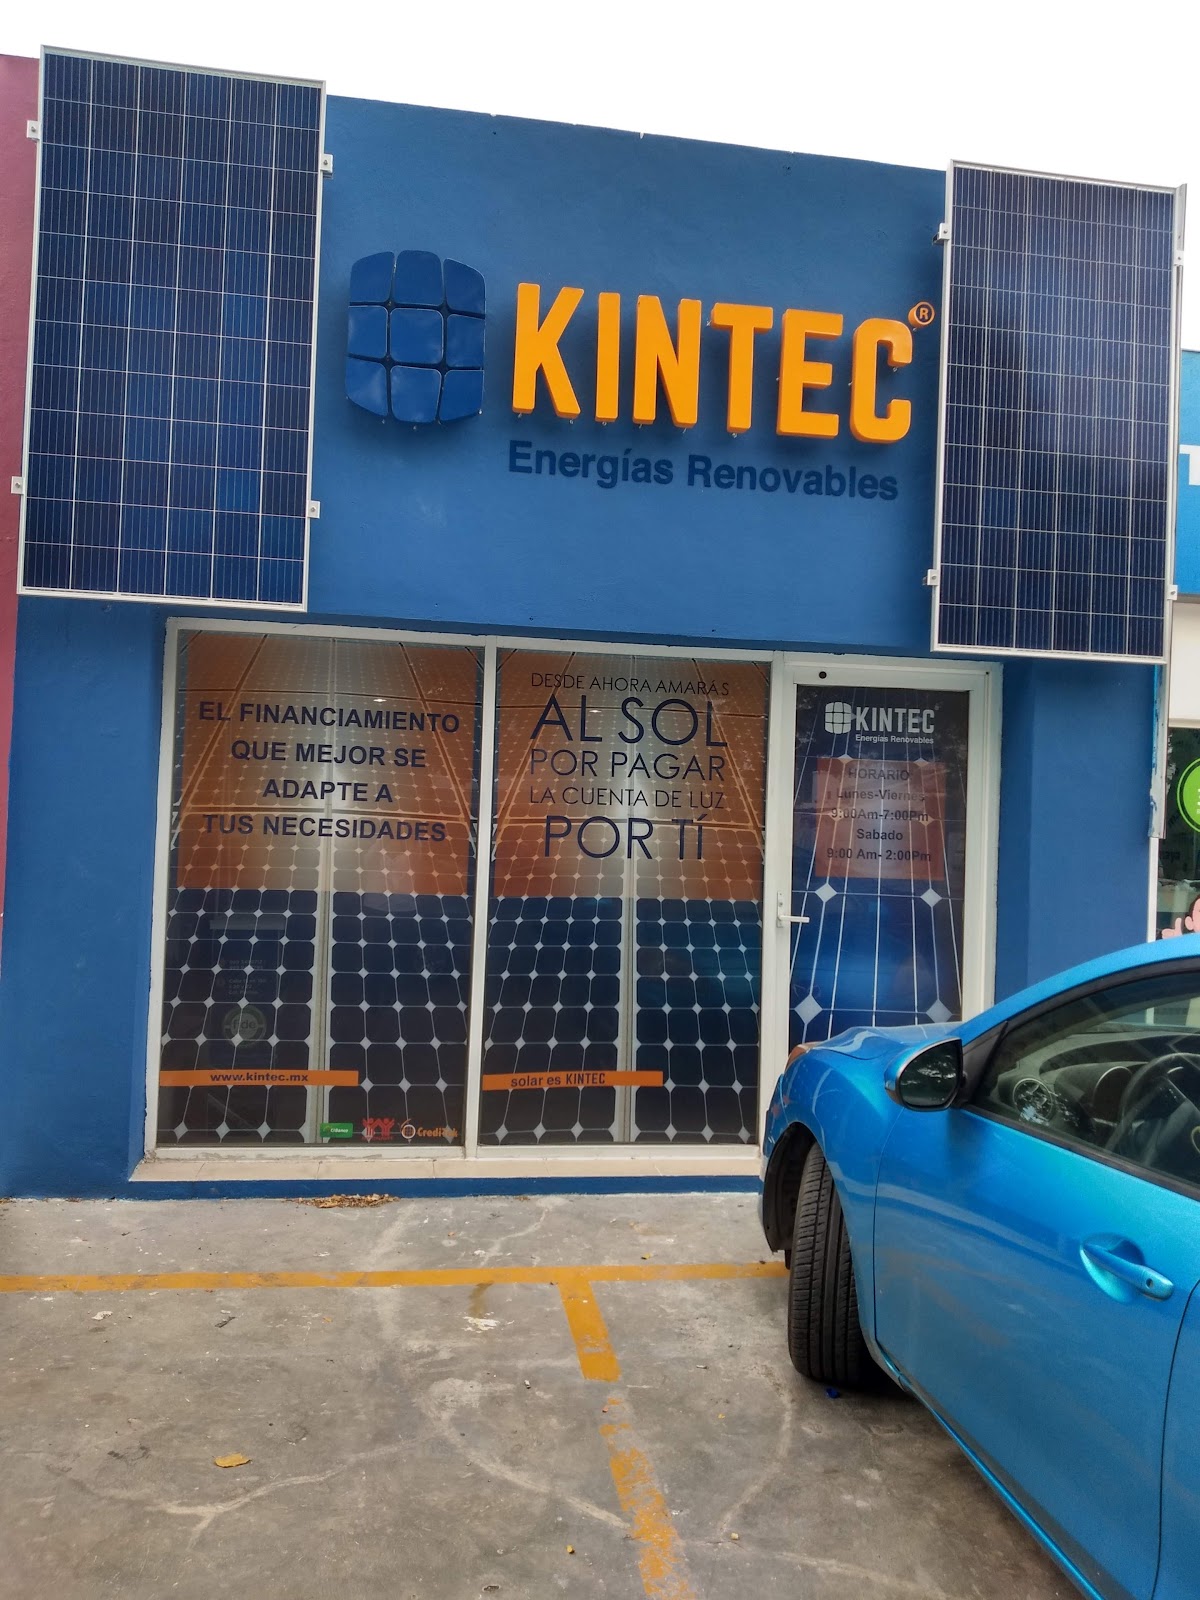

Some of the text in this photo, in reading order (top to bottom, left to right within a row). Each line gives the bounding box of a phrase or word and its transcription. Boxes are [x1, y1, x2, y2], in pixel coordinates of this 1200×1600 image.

[512, 282, 914, 443] KINTEC
[508, 439, 899, 501] Energías Renovables
[531, 672, 729, 696] DESDE AHORA AMARÁS
[199, 701, 461, 733] EL FINANCIAMIENTO
[530, 694, 728, 747] AL SOL
[855, 706, 935, 734] KINTEC
[890, 735, 934, 744] Renovables
[231, 740, 426, 767] QUE MEJOR SE
[530, 749, 725, 781] POR PAGAR
[262, 779, 393, 803] ADAPTE A
[530, 786, 724, 809] LA CUENTA DE LUZ
[203, 814, 446, 841] TUS NECESIDADES
[544, 813, 708, 860] POR TÍ
[856, 828, 904, 841] Sabado
[210, 1072, 309, 1082] www.kintec.mx
[511, 1073, 606, 1087] solar es KINTEC
